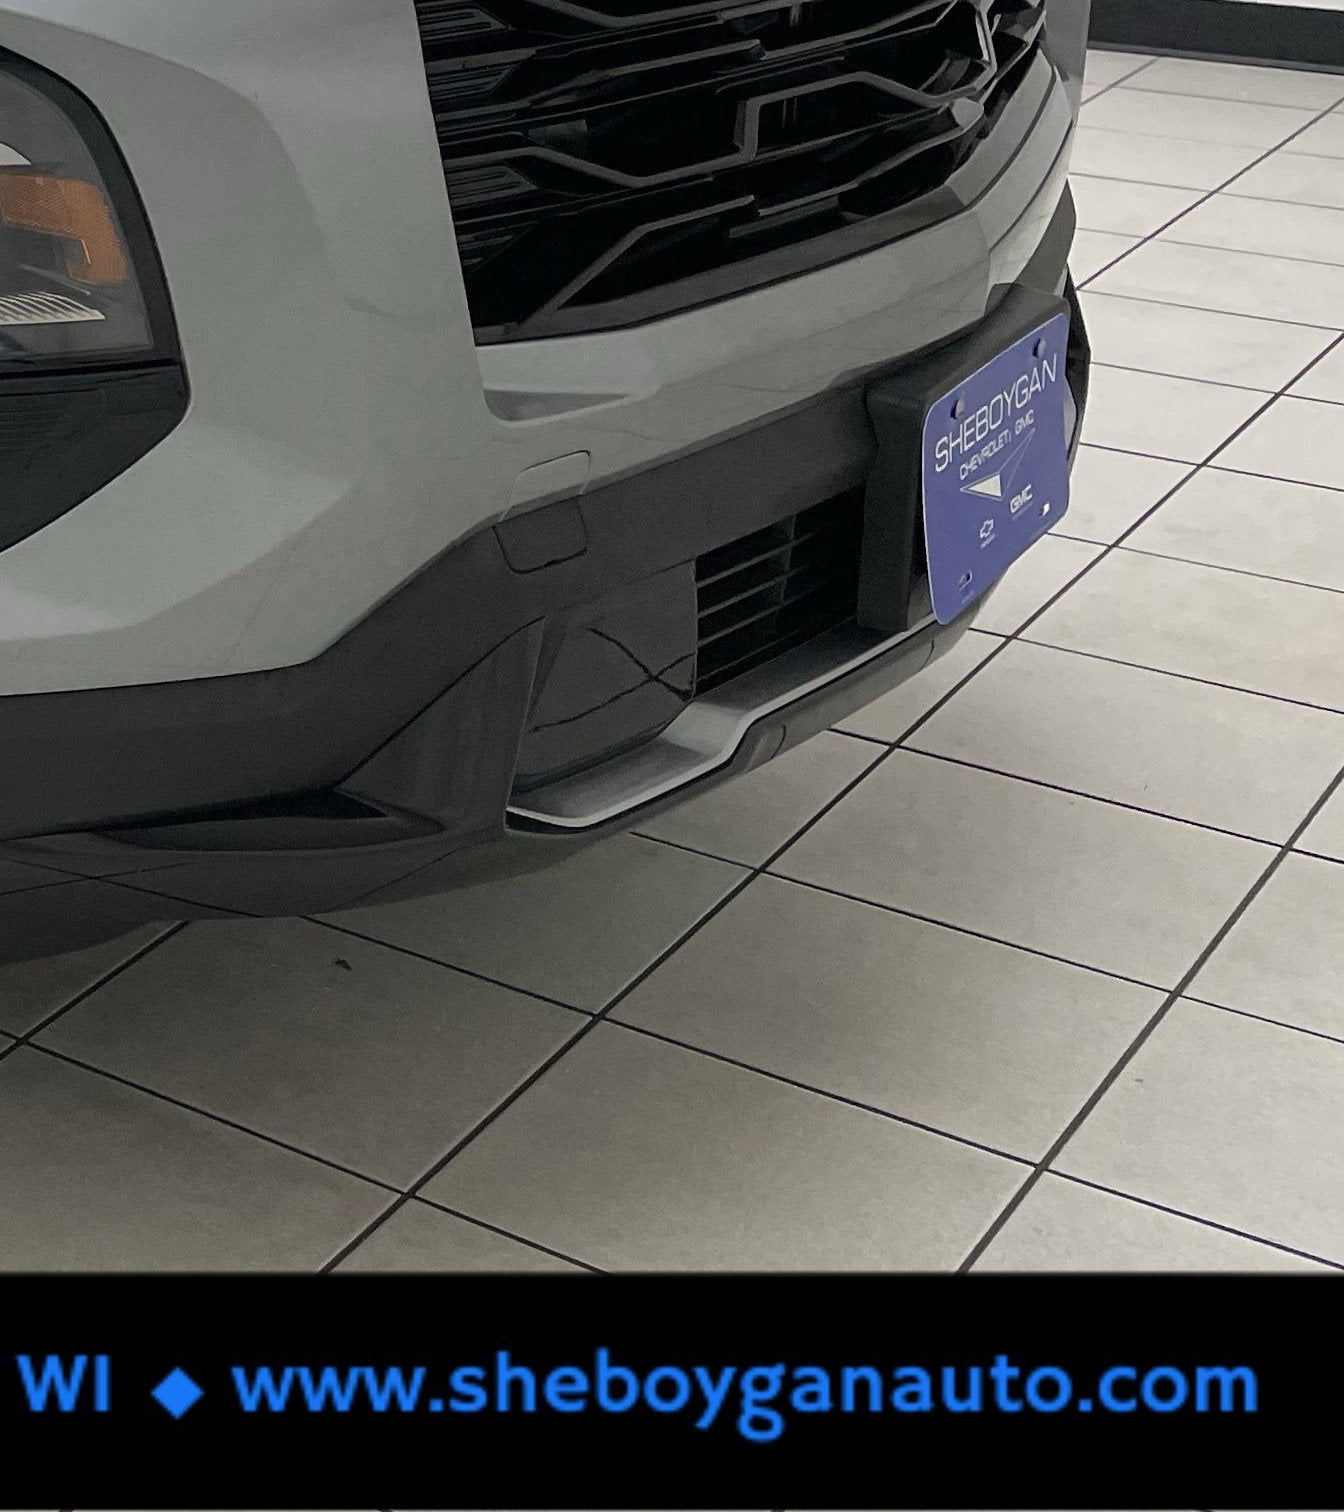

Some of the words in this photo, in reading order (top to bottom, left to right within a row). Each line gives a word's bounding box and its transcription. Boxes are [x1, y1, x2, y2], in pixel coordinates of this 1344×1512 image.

[934, 353, 1058, 473] SHEBOYGAN
[959, 429, 1010, 481] CHEVROLET
[1015, 409, 1035, 436] GMC
[1010, 484, 1033, 514] GMC
